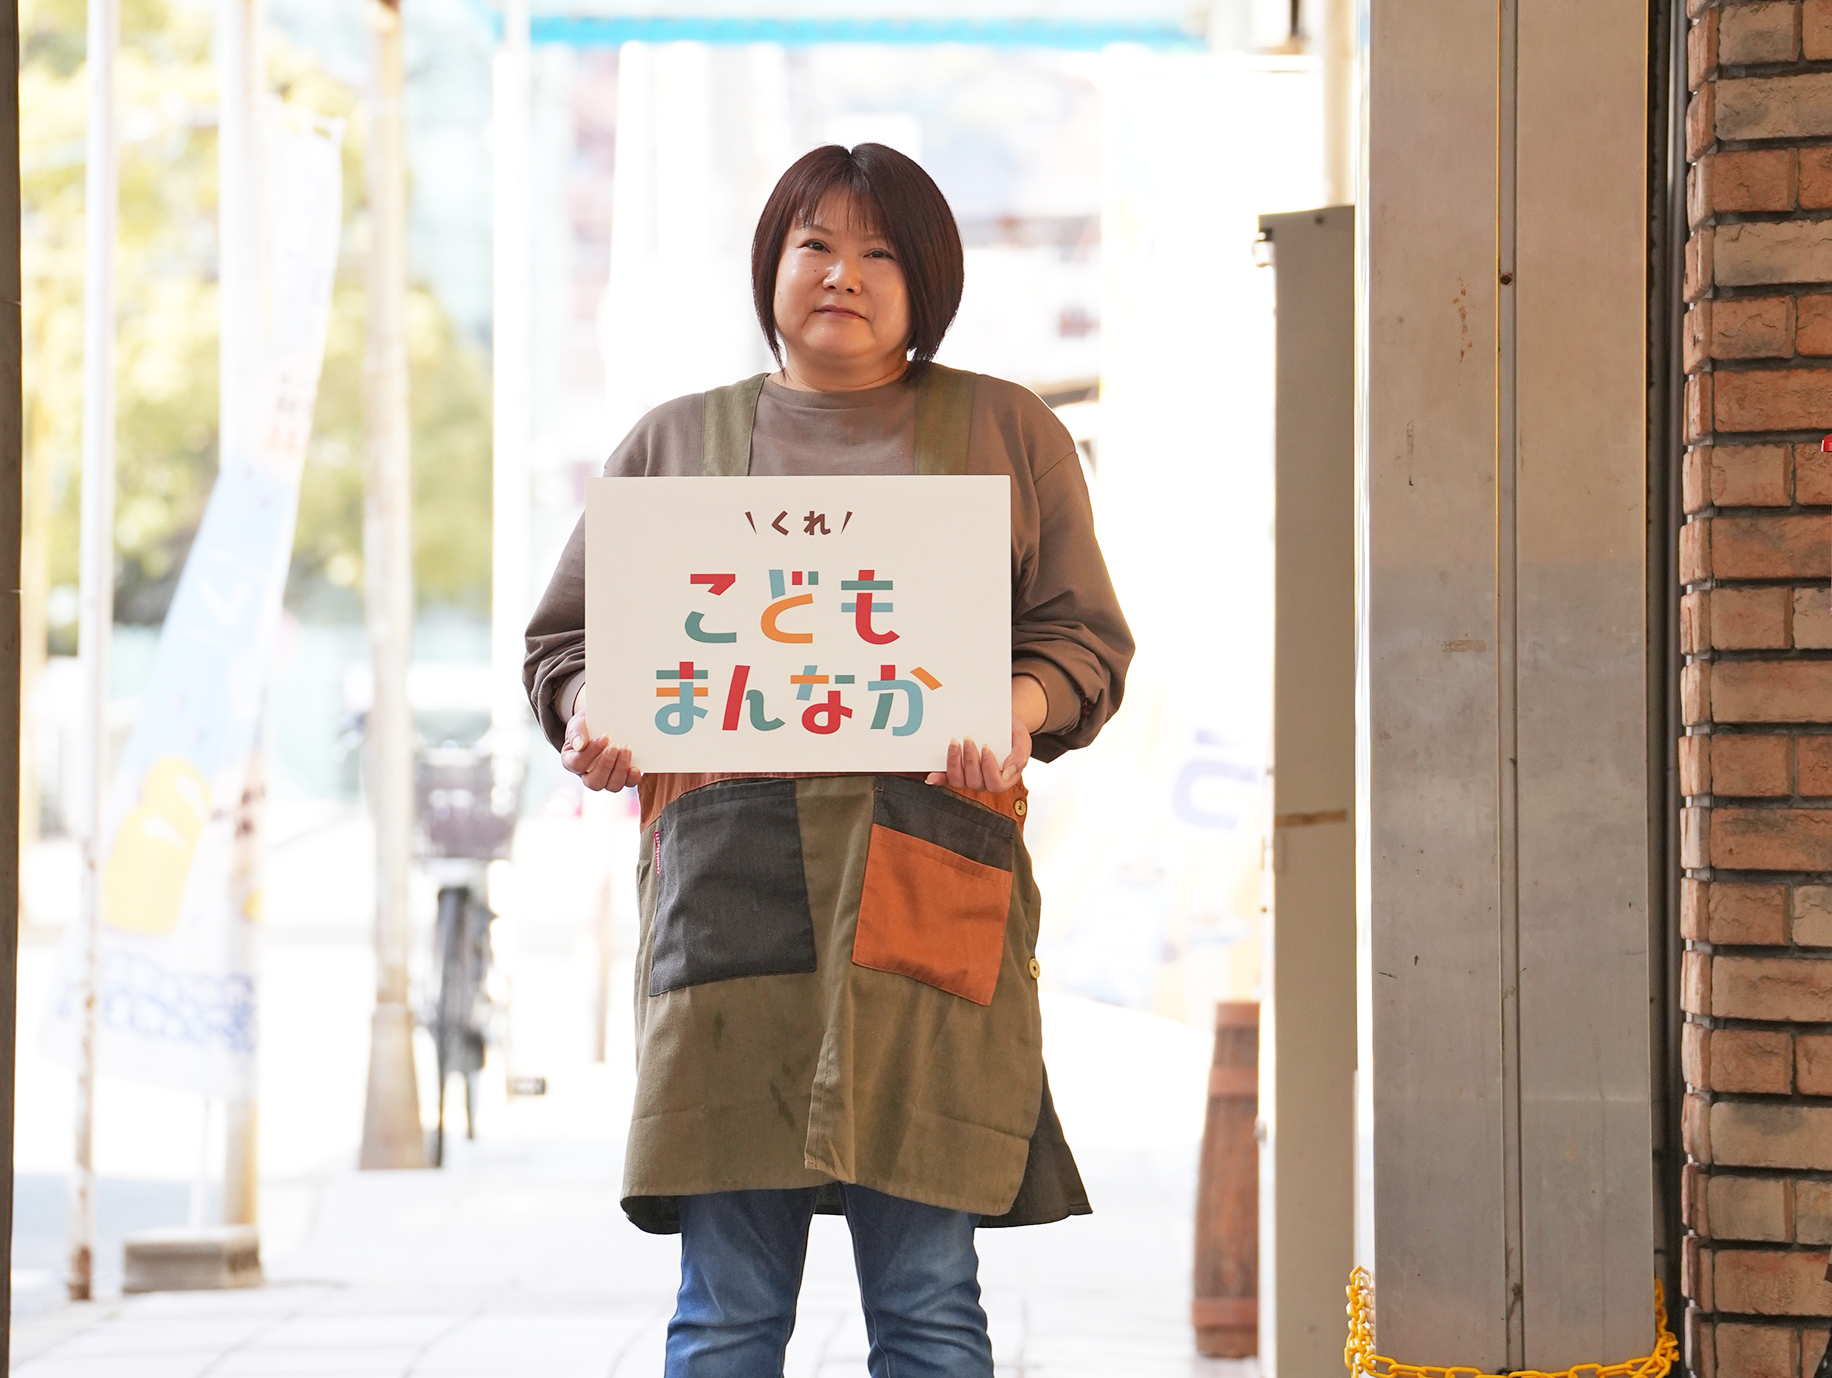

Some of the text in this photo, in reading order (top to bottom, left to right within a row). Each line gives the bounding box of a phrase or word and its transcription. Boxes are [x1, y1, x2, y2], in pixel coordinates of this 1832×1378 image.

[771, 510, 831, 536] くれ
[684, 569, 901, 645] こども
[654, 661, 943, 737] まんなか
